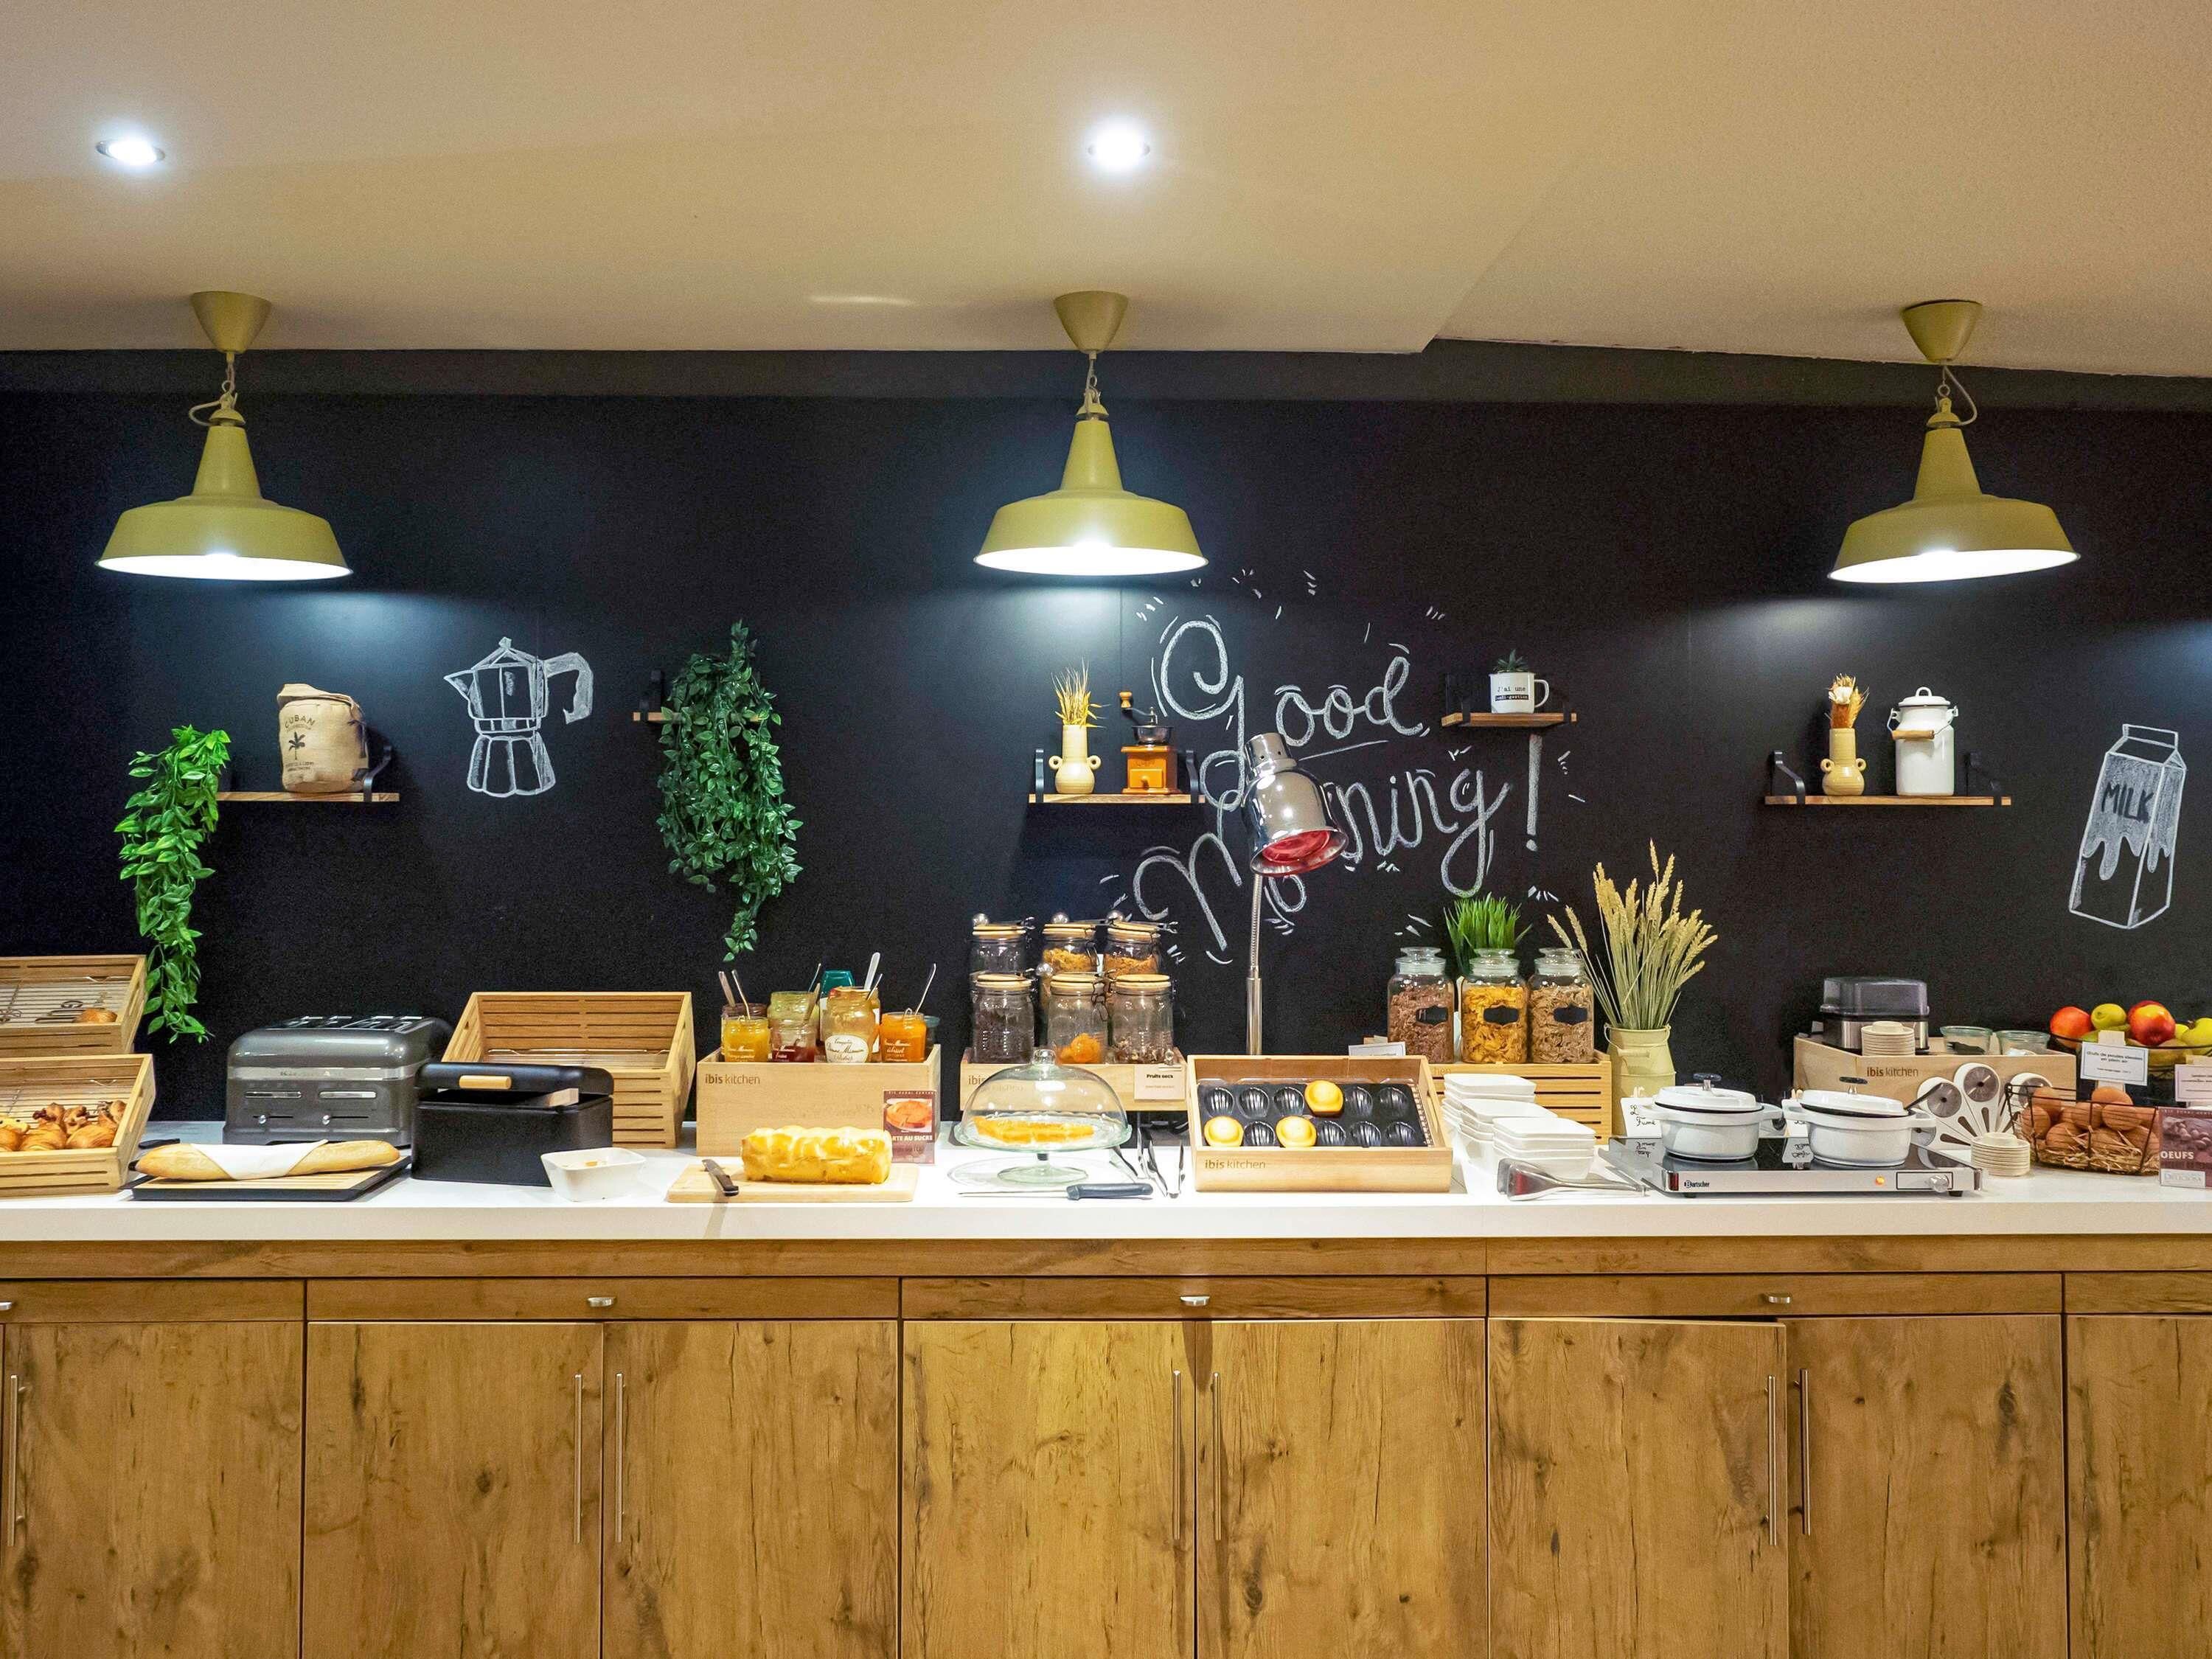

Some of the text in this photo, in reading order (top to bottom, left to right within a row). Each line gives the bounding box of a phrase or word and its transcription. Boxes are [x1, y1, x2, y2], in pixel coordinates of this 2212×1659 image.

[2101, 782, 2154, 824] MILK
[1867, 1067, 1919, 1077] ibis kitchen
[705, 1074, 761, 1085] ibis kitchen
[2160, 1150, 2194, 1160] OEUFS
[1205, 1159, 1267, 1169] ibis kitchen
